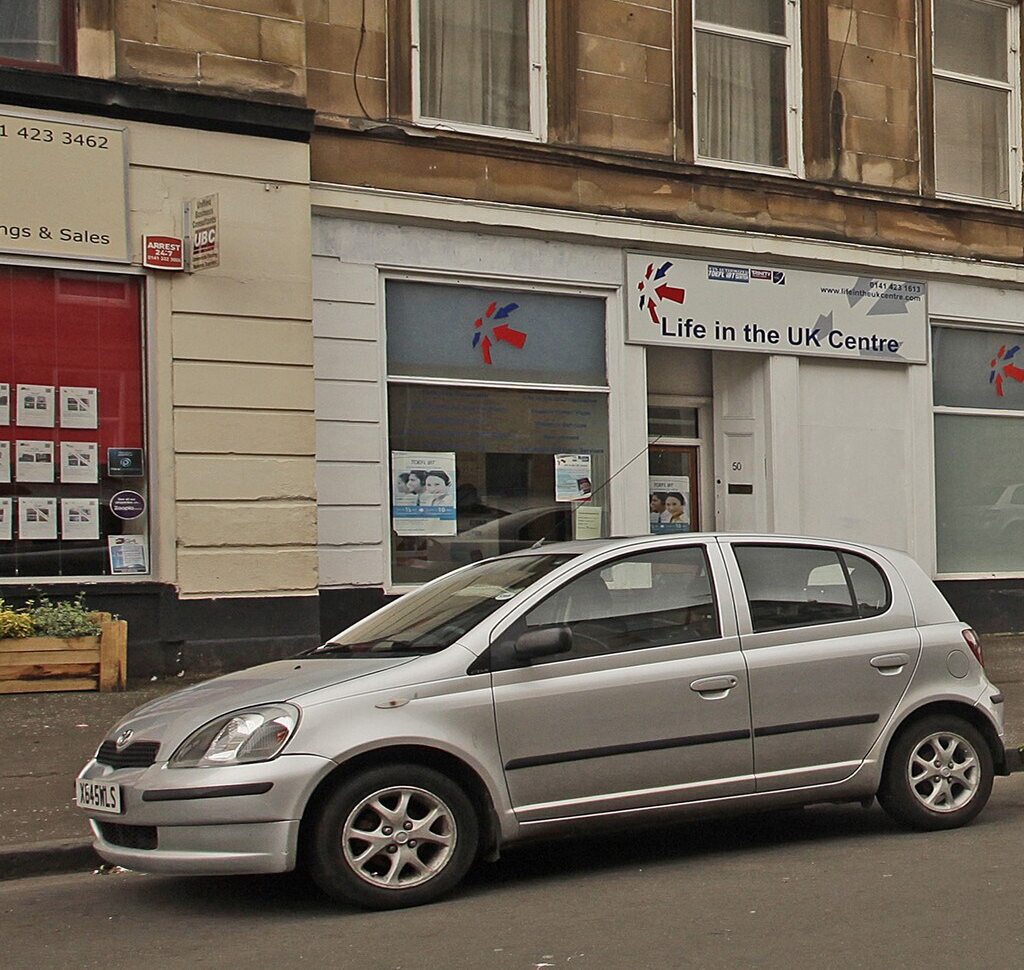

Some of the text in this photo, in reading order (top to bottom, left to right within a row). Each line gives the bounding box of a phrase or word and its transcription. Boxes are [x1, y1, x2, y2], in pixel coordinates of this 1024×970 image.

[17, 127, 54, 142] 423
[62, 132, 108, 149] 3462
[39, 226, 53, 240] &
[60, 228, 110, 245] Sales
[194, 229, 216, 247] UBC
[147, 242, 181, 251] ARREST
[662, 316, 899, 353] Life in the UK Centre
[732, 461, 742, 471] 50
